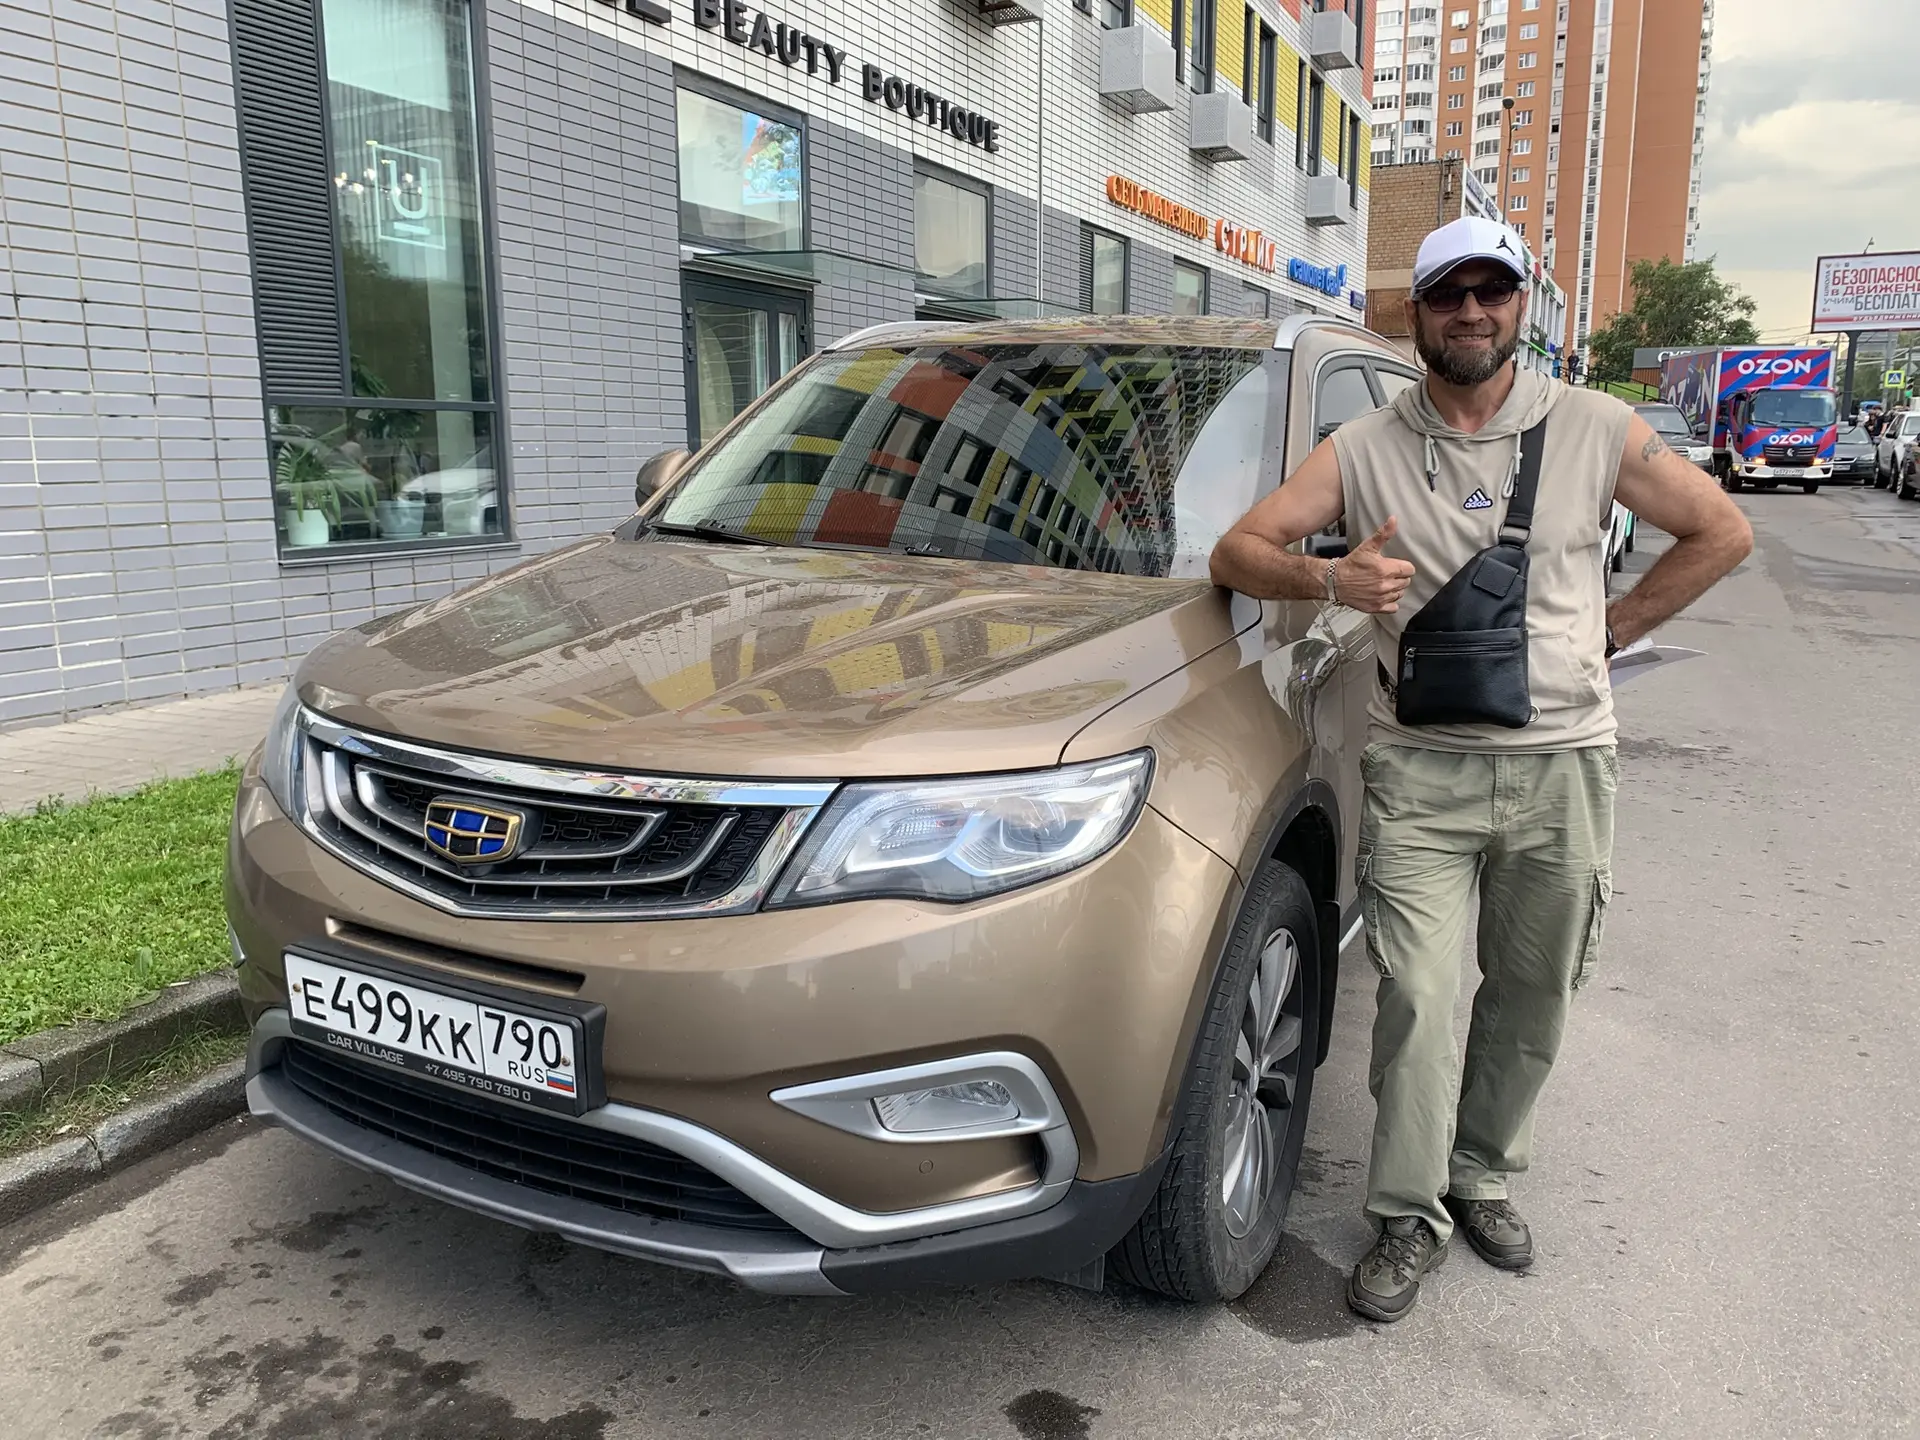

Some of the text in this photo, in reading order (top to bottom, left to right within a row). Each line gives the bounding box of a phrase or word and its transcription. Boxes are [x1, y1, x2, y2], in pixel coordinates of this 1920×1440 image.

[693, 0, 999, 153] BEAUTY BOUTIQUE
[1109, 175, 1144, 211] СЕТЬ
[1823, 296, 1854, 305] УЧИМ
[1738, 358, 1811, 375] OZON
[1768, 434, 1814, 444] OZON
[327, 1032, 353, 1050] CAR
[424, 1063, 440, 1076] +7
[442, 1067, 466, 1084] 495
[467, 1073, 492, 1091] 790
[494, 1081, 519, 1098] 790
[507, 1061, 545, 1083] RUS
